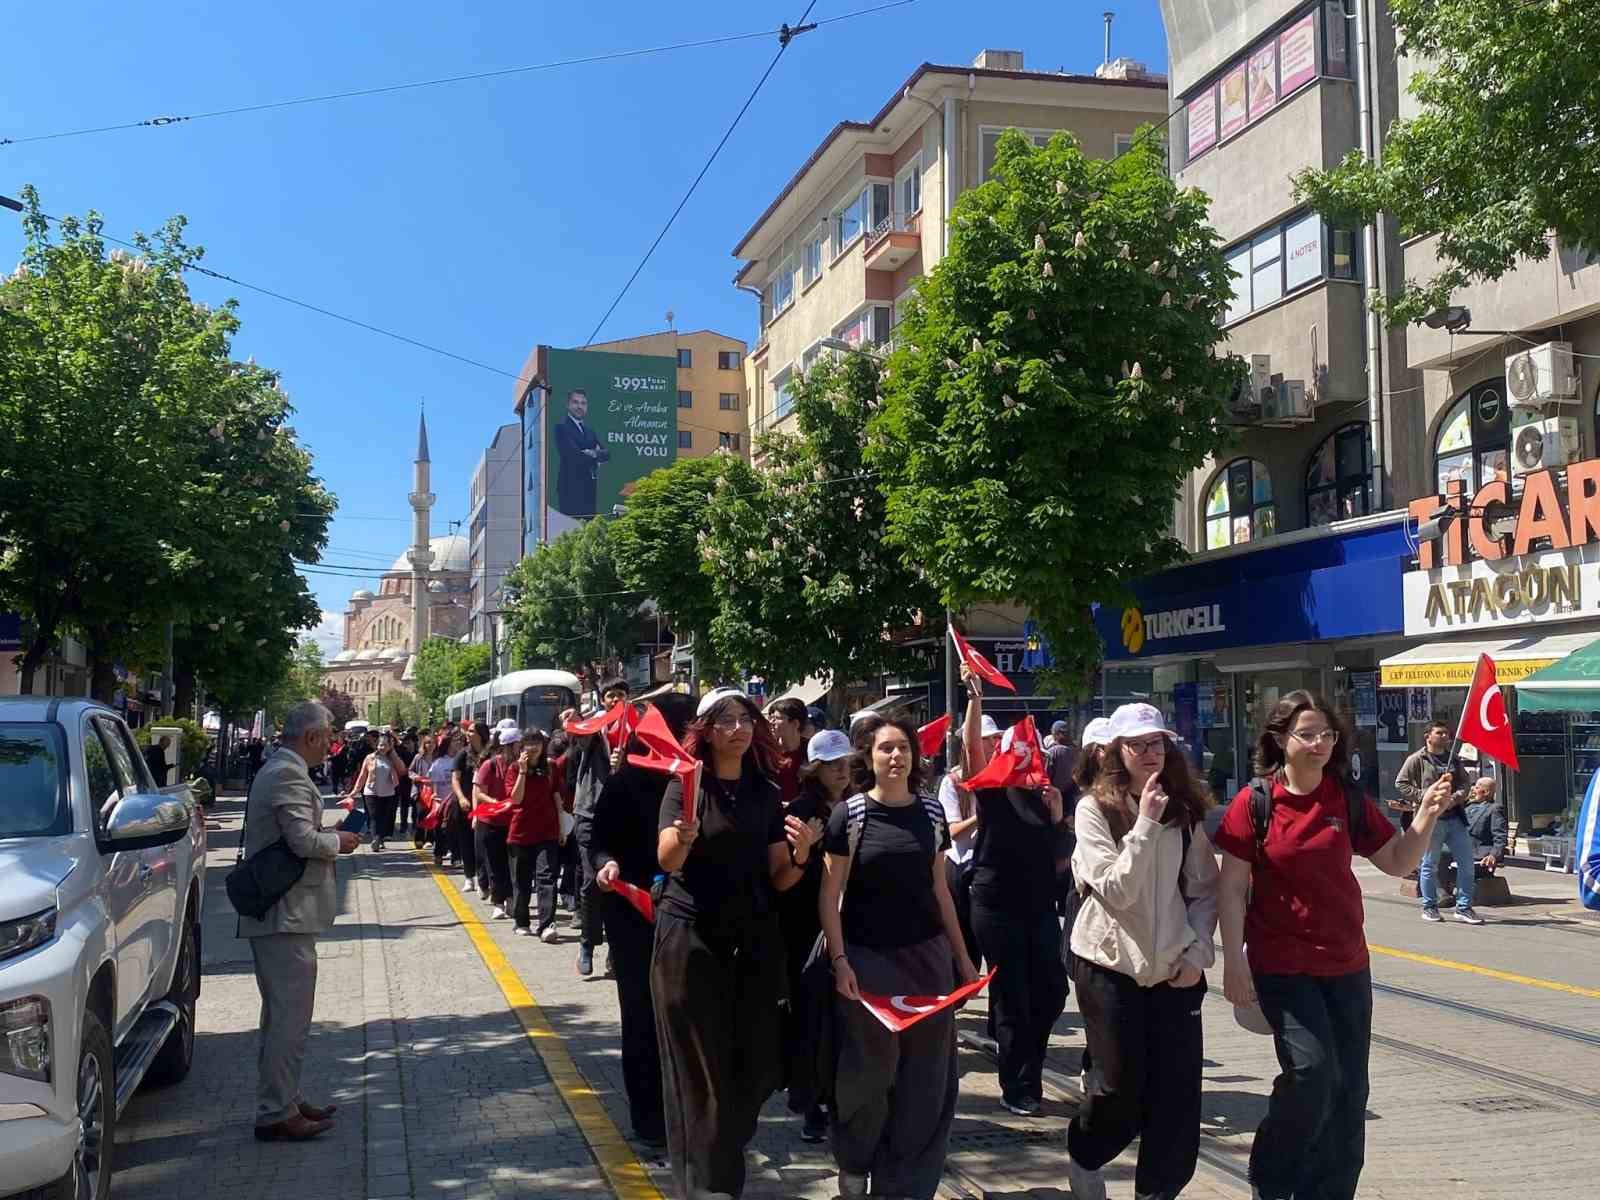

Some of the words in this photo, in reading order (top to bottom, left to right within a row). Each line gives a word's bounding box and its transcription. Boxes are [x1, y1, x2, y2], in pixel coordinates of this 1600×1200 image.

[608, 432, 624, 442] EN
[626, 433, 668, 444] KOLAY
[635, 446, 668, 457] YOLU
[1143, 604, 1226, 640] TURKCELL
